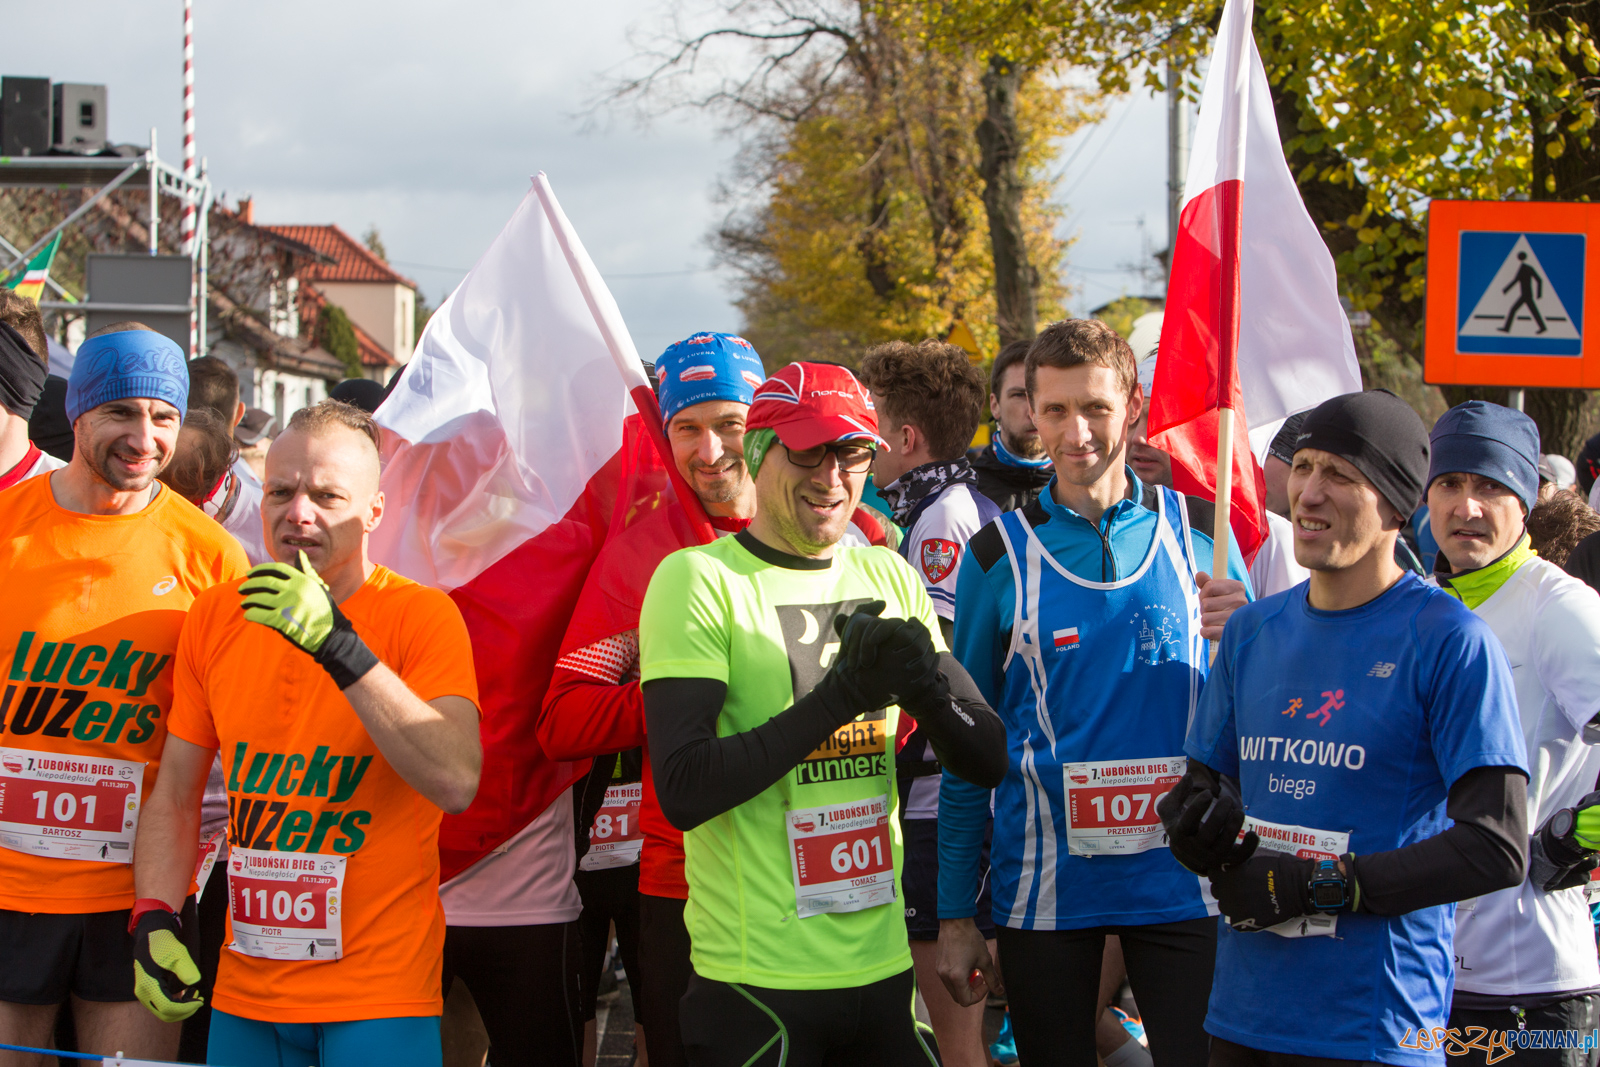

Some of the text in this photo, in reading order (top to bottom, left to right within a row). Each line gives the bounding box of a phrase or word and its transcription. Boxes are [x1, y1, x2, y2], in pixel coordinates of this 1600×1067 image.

[687, 350, 715, 358] LUVENA
[86, 346, 189, 401] Jeste
[686, 392, 717, 402] LUVENA
[1055, 643, 1081, 653] POLAND
[8, 630, 171, 697] Lucky
[1240, 736, 1366, 770] WITKOWO
[27, 758, 114, 776] 7. LUBOŃSKI BIEG
[228, 741, 374, 803] Lucky
[798, 754, 887, 783] runners
[1091, 768, 1101, 780] 7.
[1101, 765, 1145, 777] LUBOŃSKI
[1147, 764, 1168, 774] BIEG
[36, 770, 95, 783] Niepodległości
[1101, 776, 1153, 785] Niepodległości
[101, 781, 129, 789] 11.11.2017
[1268, 773, 1316, 800] biega
[621, 788, 640, 798] BIEG
[32, 790, 97, 824] 101
[818, 812, 829, 827] 7.
[829, 803, 870, 822] LUBOŃSKI
[870, 802, 882, 814] BIEG
[589, 814, 629, 839] 81
[830, 815, 876, 831] Niepodległości
[1107, 825, 1157, 836] PRZEMYSŁAW
[42, 827, 82, 838] BARTOSZ
[1292, 832, 1316, 846] BIEG
[595, 843, 615, 852] PIOTR
[830, 836, 883, 874] 601
[249, 856, 289, 869] LUBOŃSKI
[292, 859, 315, 871] BIEG
[798, 853, 807, 878] STREFA
[249, 868, 296, 879] Niepodległości
[302, 876, 331, 884] 11.11.2017
[850, 875, 877, 887] TOMASZ
[241, 887, 316, 922] 1106
[261, 927, 282, 936] PIOTR
